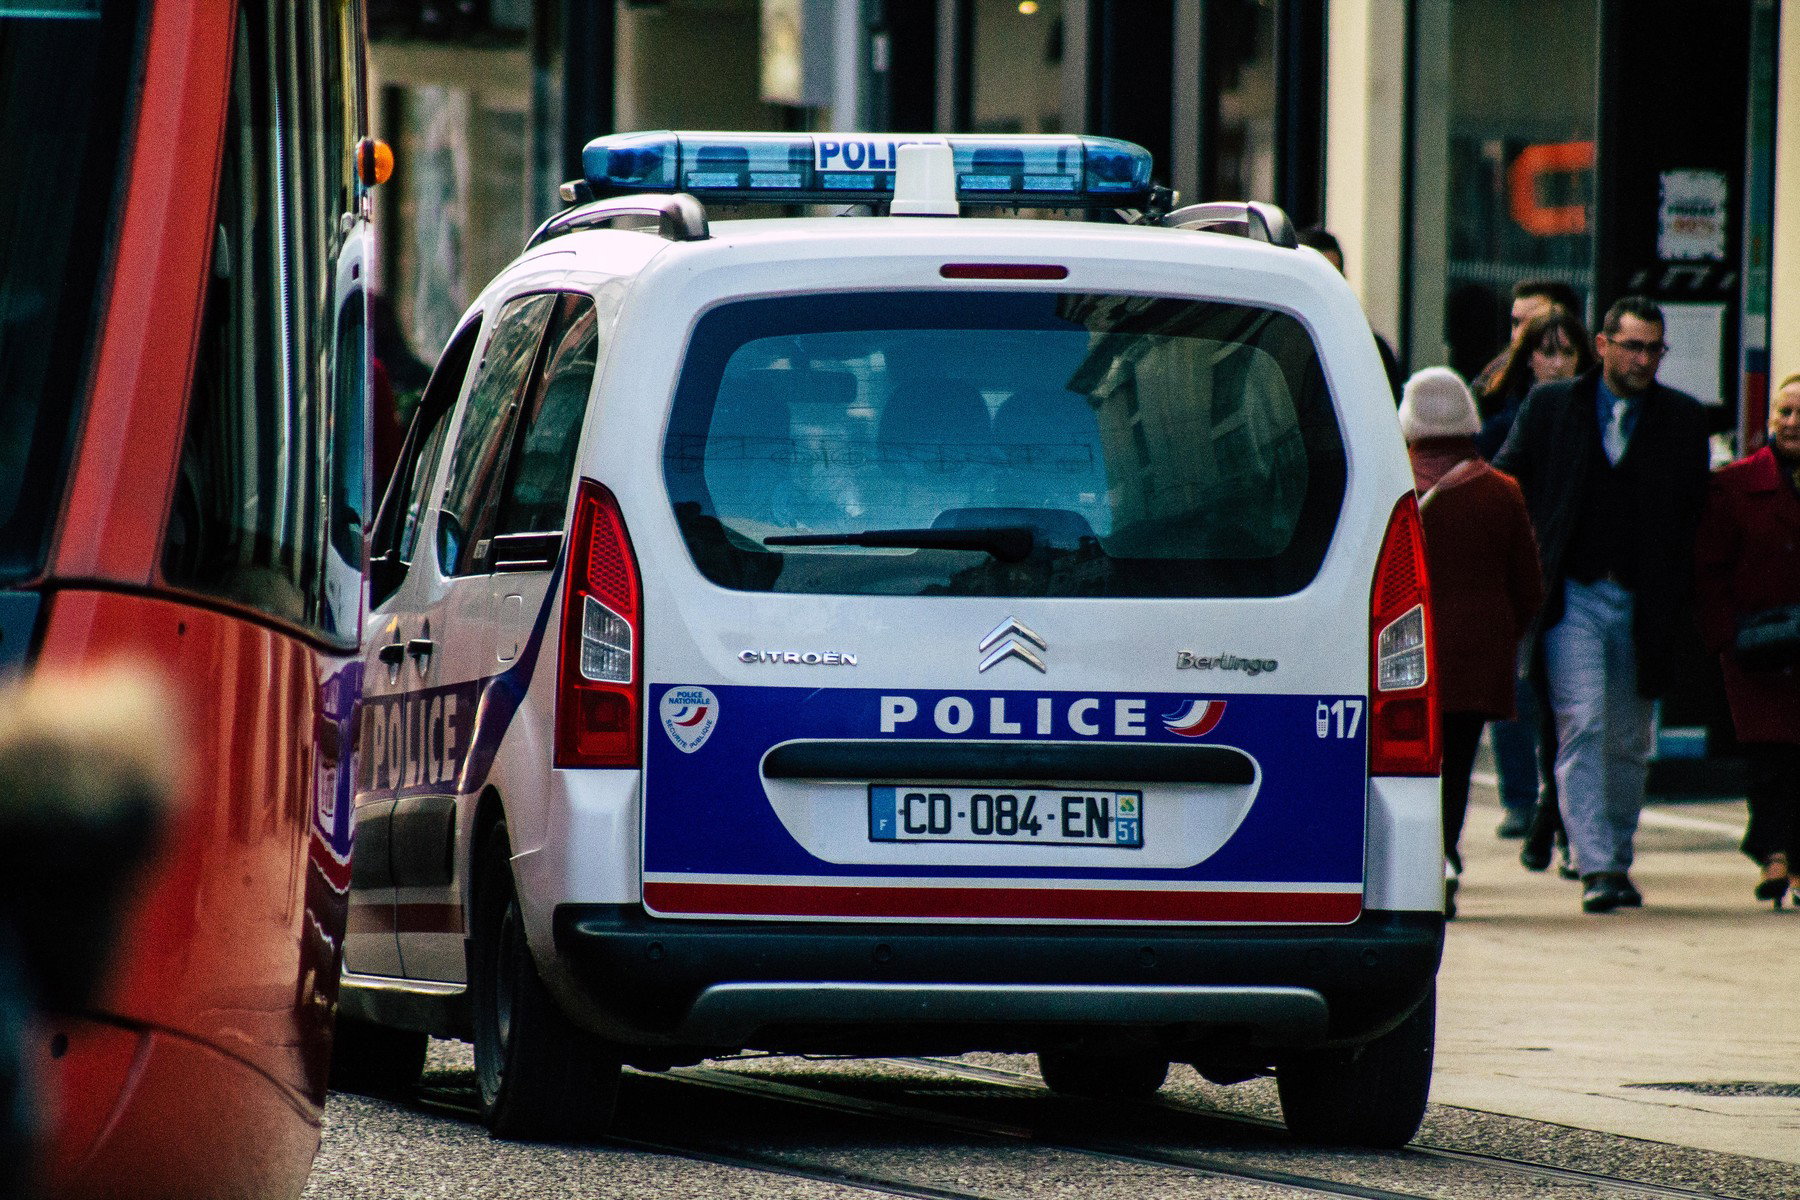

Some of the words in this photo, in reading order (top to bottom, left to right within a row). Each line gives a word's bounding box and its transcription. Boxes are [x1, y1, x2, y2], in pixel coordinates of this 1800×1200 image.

[820, 141, 941, 169] POLI
[737, 650, 858, 666] CITROËN
[1176, 650, 1279, 676] Berlingo
[879, 695, 1147, 736] POLICE
[1330, 700, 1363, 739] 17
[372, 693, 458, 791] POLICE
[689, 719, 713, 749] PUBLIQUE
[878, 818, 888, 831] F
[903, 793, 1109, 838] CD-084-EN
[1118, 821, 1138, 841] 51
